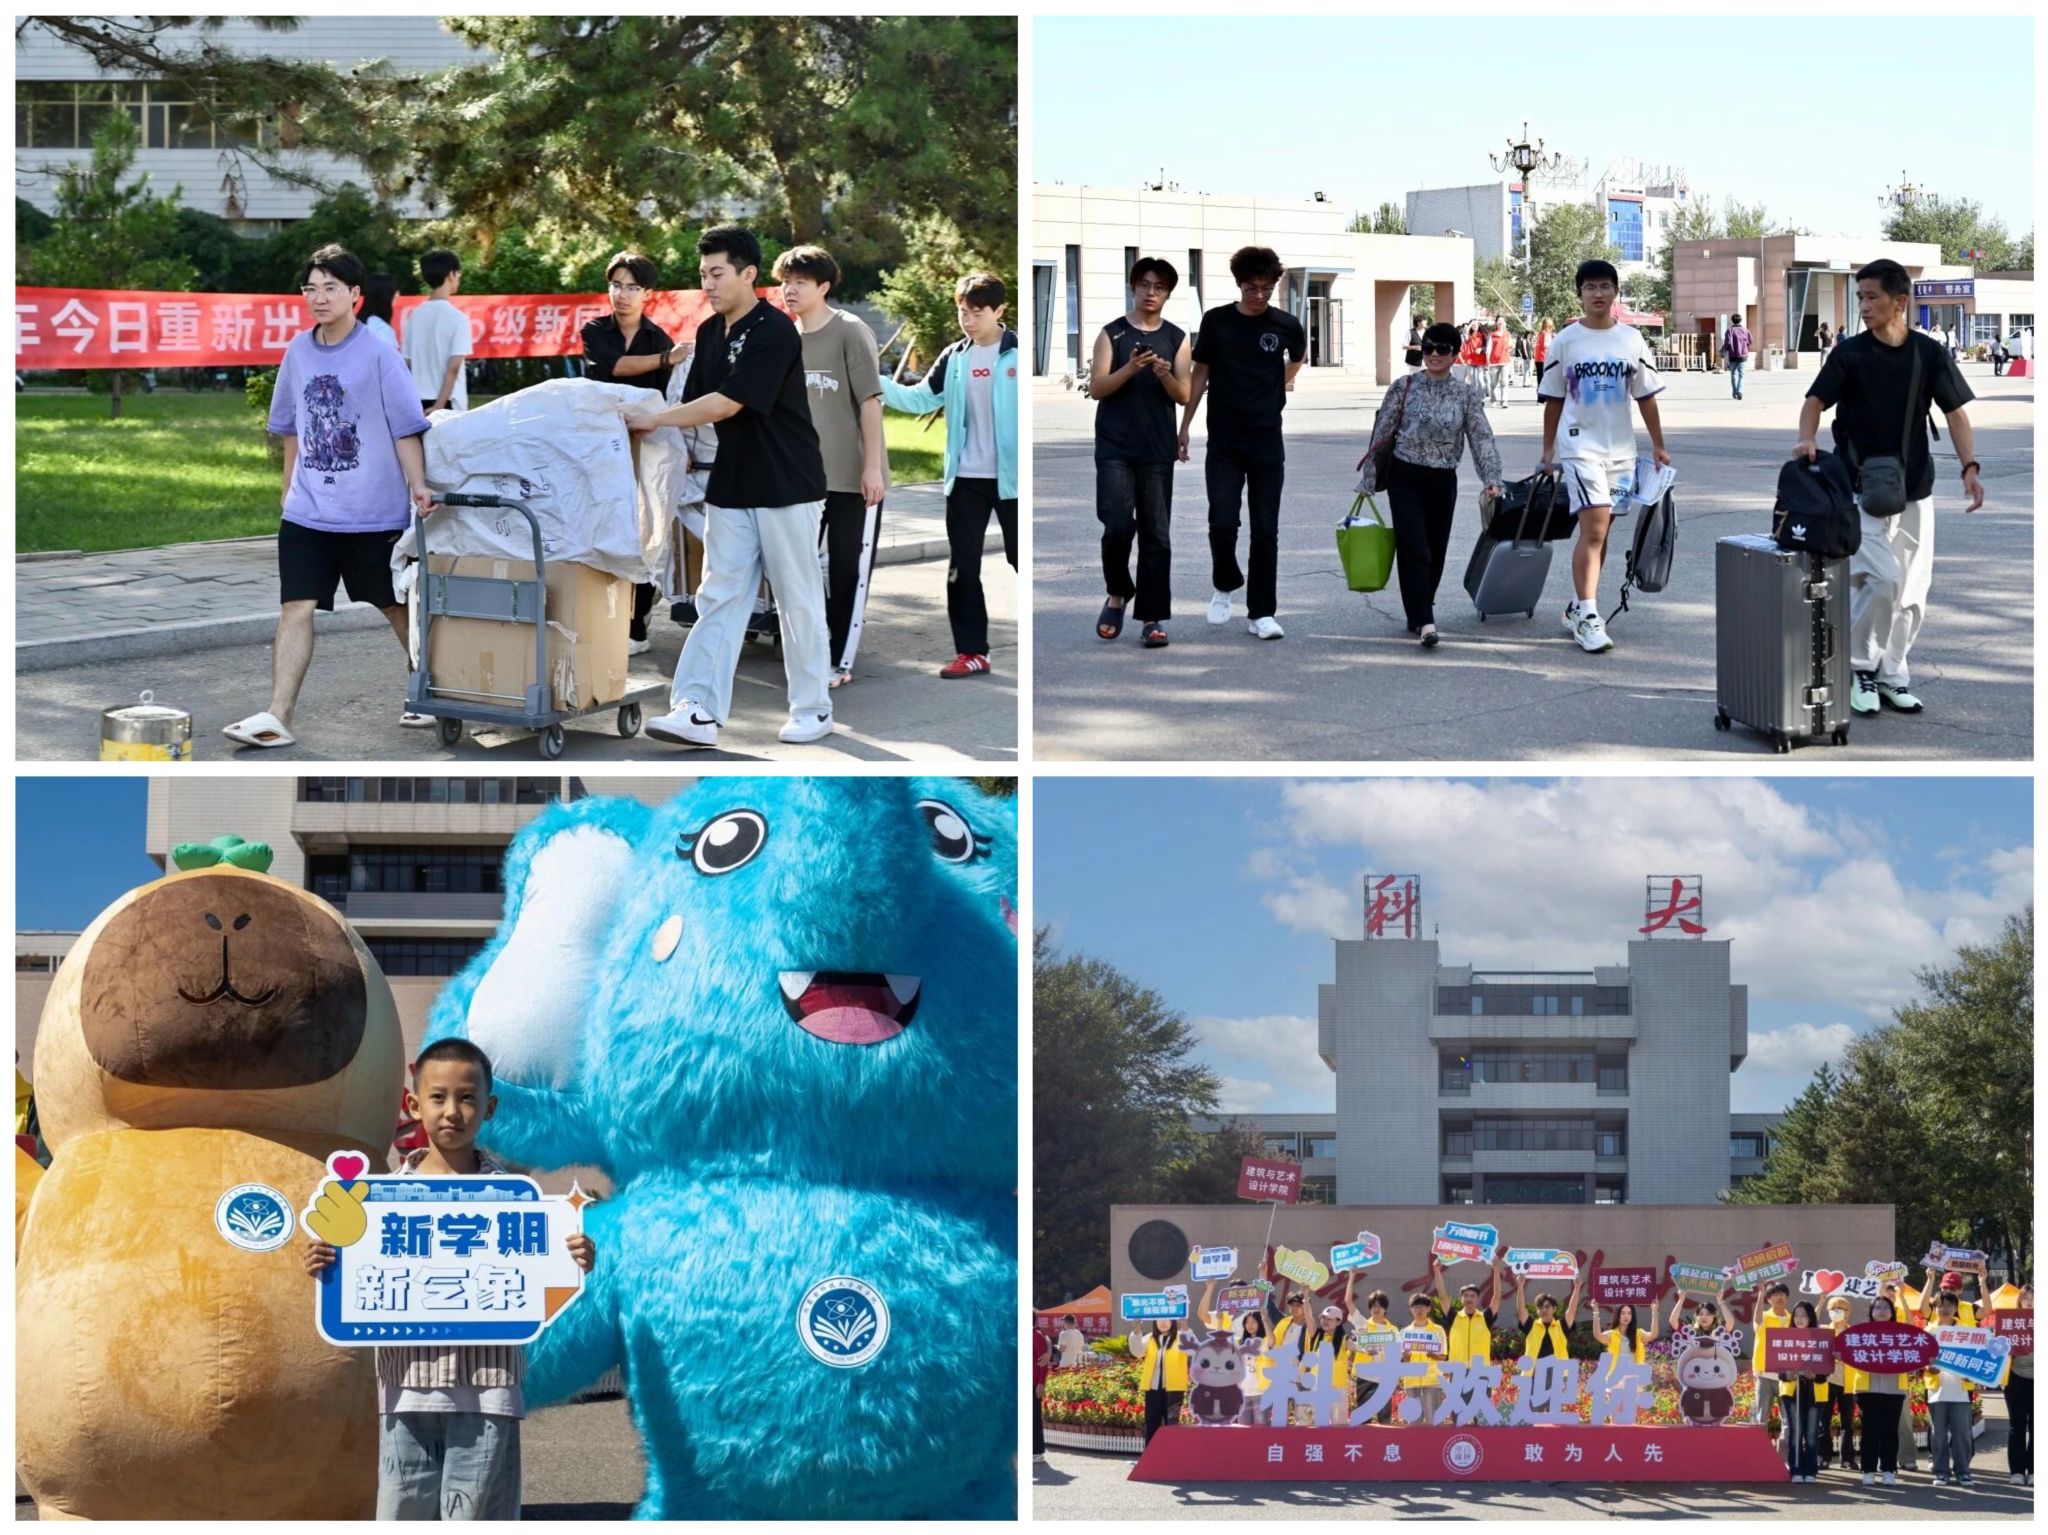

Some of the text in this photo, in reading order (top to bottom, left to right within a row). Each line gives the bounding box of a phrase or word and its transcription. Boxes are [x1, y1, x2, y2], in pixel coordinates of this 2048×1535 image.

[1364, 874, 1708, 939] 科 大
[1245, 1165, 1297, 1183] 建筑与艺术
[1248, 1179, 1289, 1196] 设计学院
[380, 1211, 551, 1258] 新学期
[1202, 1254, 1231, 1264] 新学期
[1743, 1245, 1790, 1269] 扬帆启航
[354, 1263, 529, 1312] 新气象
[1598, 1275, 1652, 1285] 建筑与艺术
[1803, 1271, 1814, 1292] I
[1228, 1289, 1258, 1299] 新学期
[1604, 1287, 1647, 1298] 设计学院
[1220, 1298, 1260, 1309] 元气满满
[1772, 1339, 1829, 1348] 建筑与艺术
[1845, 1333, 1929, 1347] 建筑与艺术
[1939, 1330, 1987, 1344] 新学期
[1777, 1353, 1823, 1362] 设计学院
[1852, 1349, 1921, 1363] 设计学院
[1937, 1349, 1997, 1375] 迎新同学
[1261, 1339, 1654, 1427] 科大欢迎你
[1267, 1443, 1664, 1463] 自强不息 敢为人先
